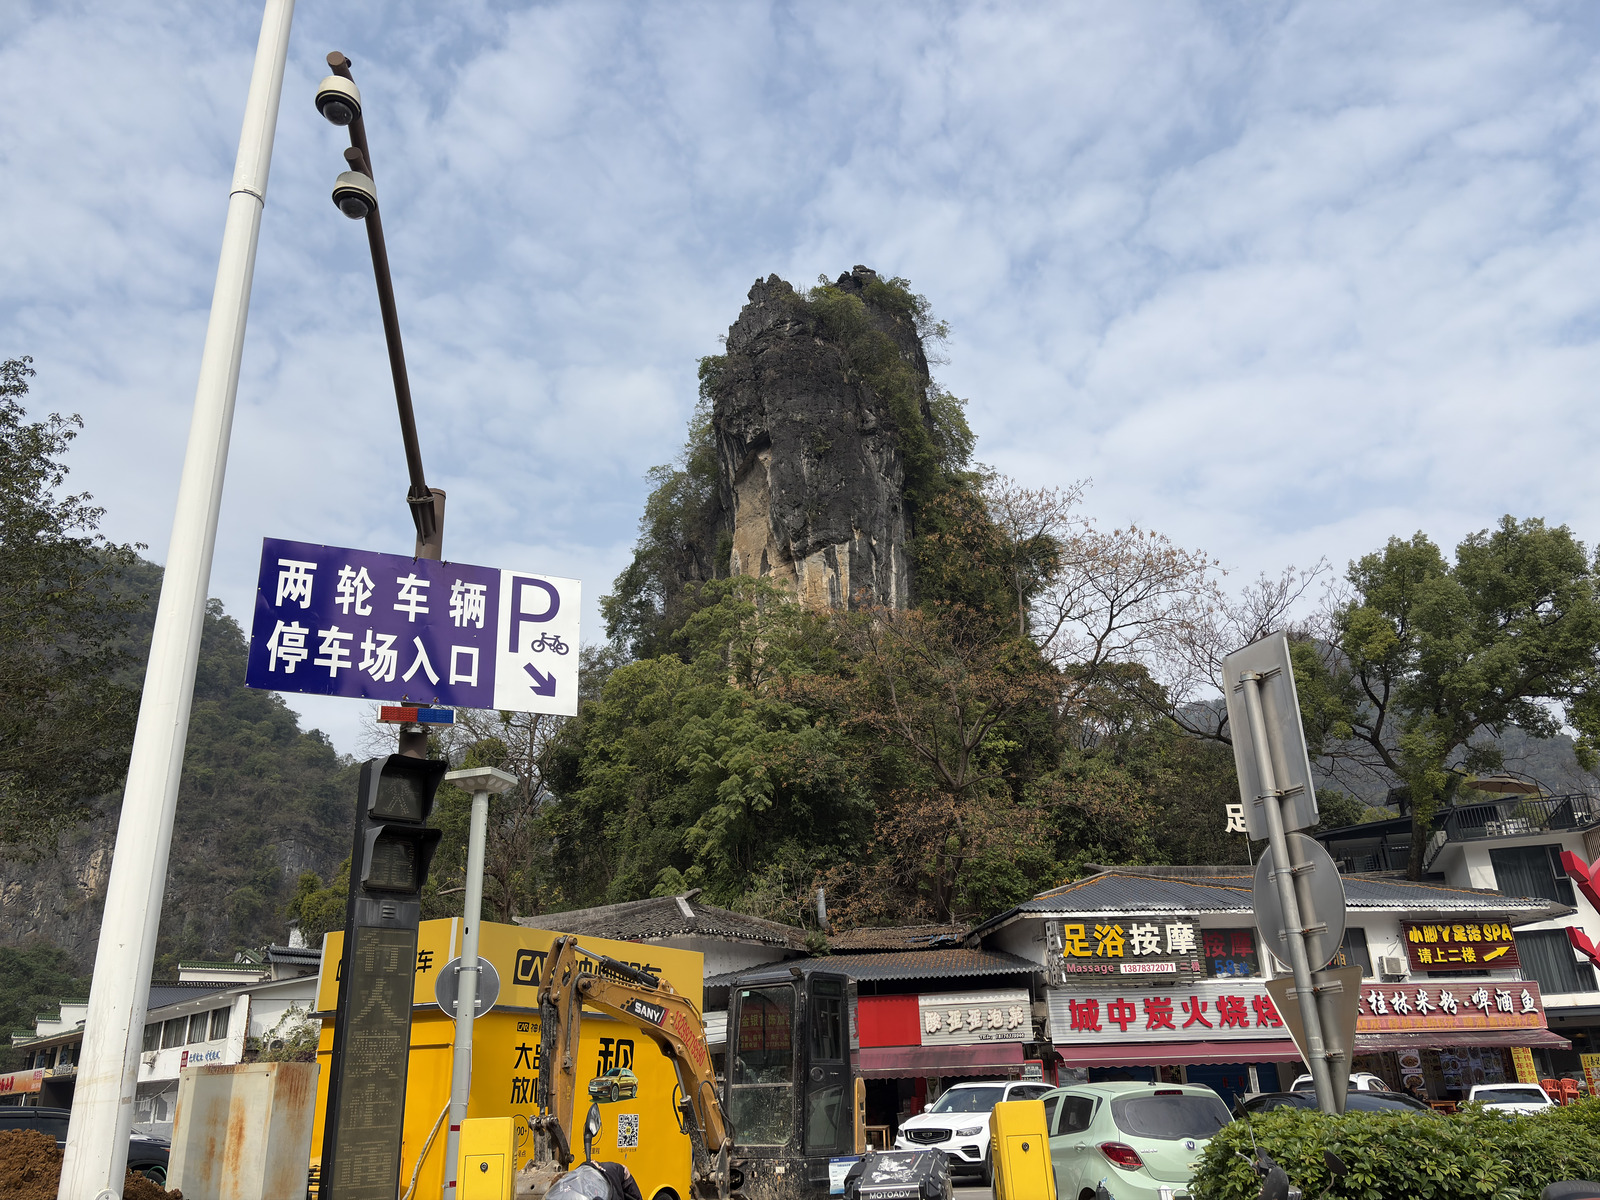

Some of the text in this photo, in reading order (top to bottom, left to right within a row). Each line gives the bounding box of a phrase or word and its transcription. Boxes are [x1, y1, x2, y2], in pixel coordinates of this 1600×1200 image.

[275, 558, 487, 629] 两轮车辆
[508, 575, 561, 654] P
[266, 620, 480, 687] 停车场入口
[1063, 922, 1197, 958] 足浴按摩
[1202, 931, 1254, 958] 按摩
[1066, 963, 1114, 974] Massage
[1122, 964, 1175, 973] 13878372071
[1418, 946, 1477, 964] 请上二楼
[634, 1002, 660, 1022] SANY
[1068, 995, 1284, 1032] 城中炭火烧烤
[1357, 987, 1539, 1016] 桂林米粉·啤酒鱼
[869, 1190, 911, 1199] MOTOADV
